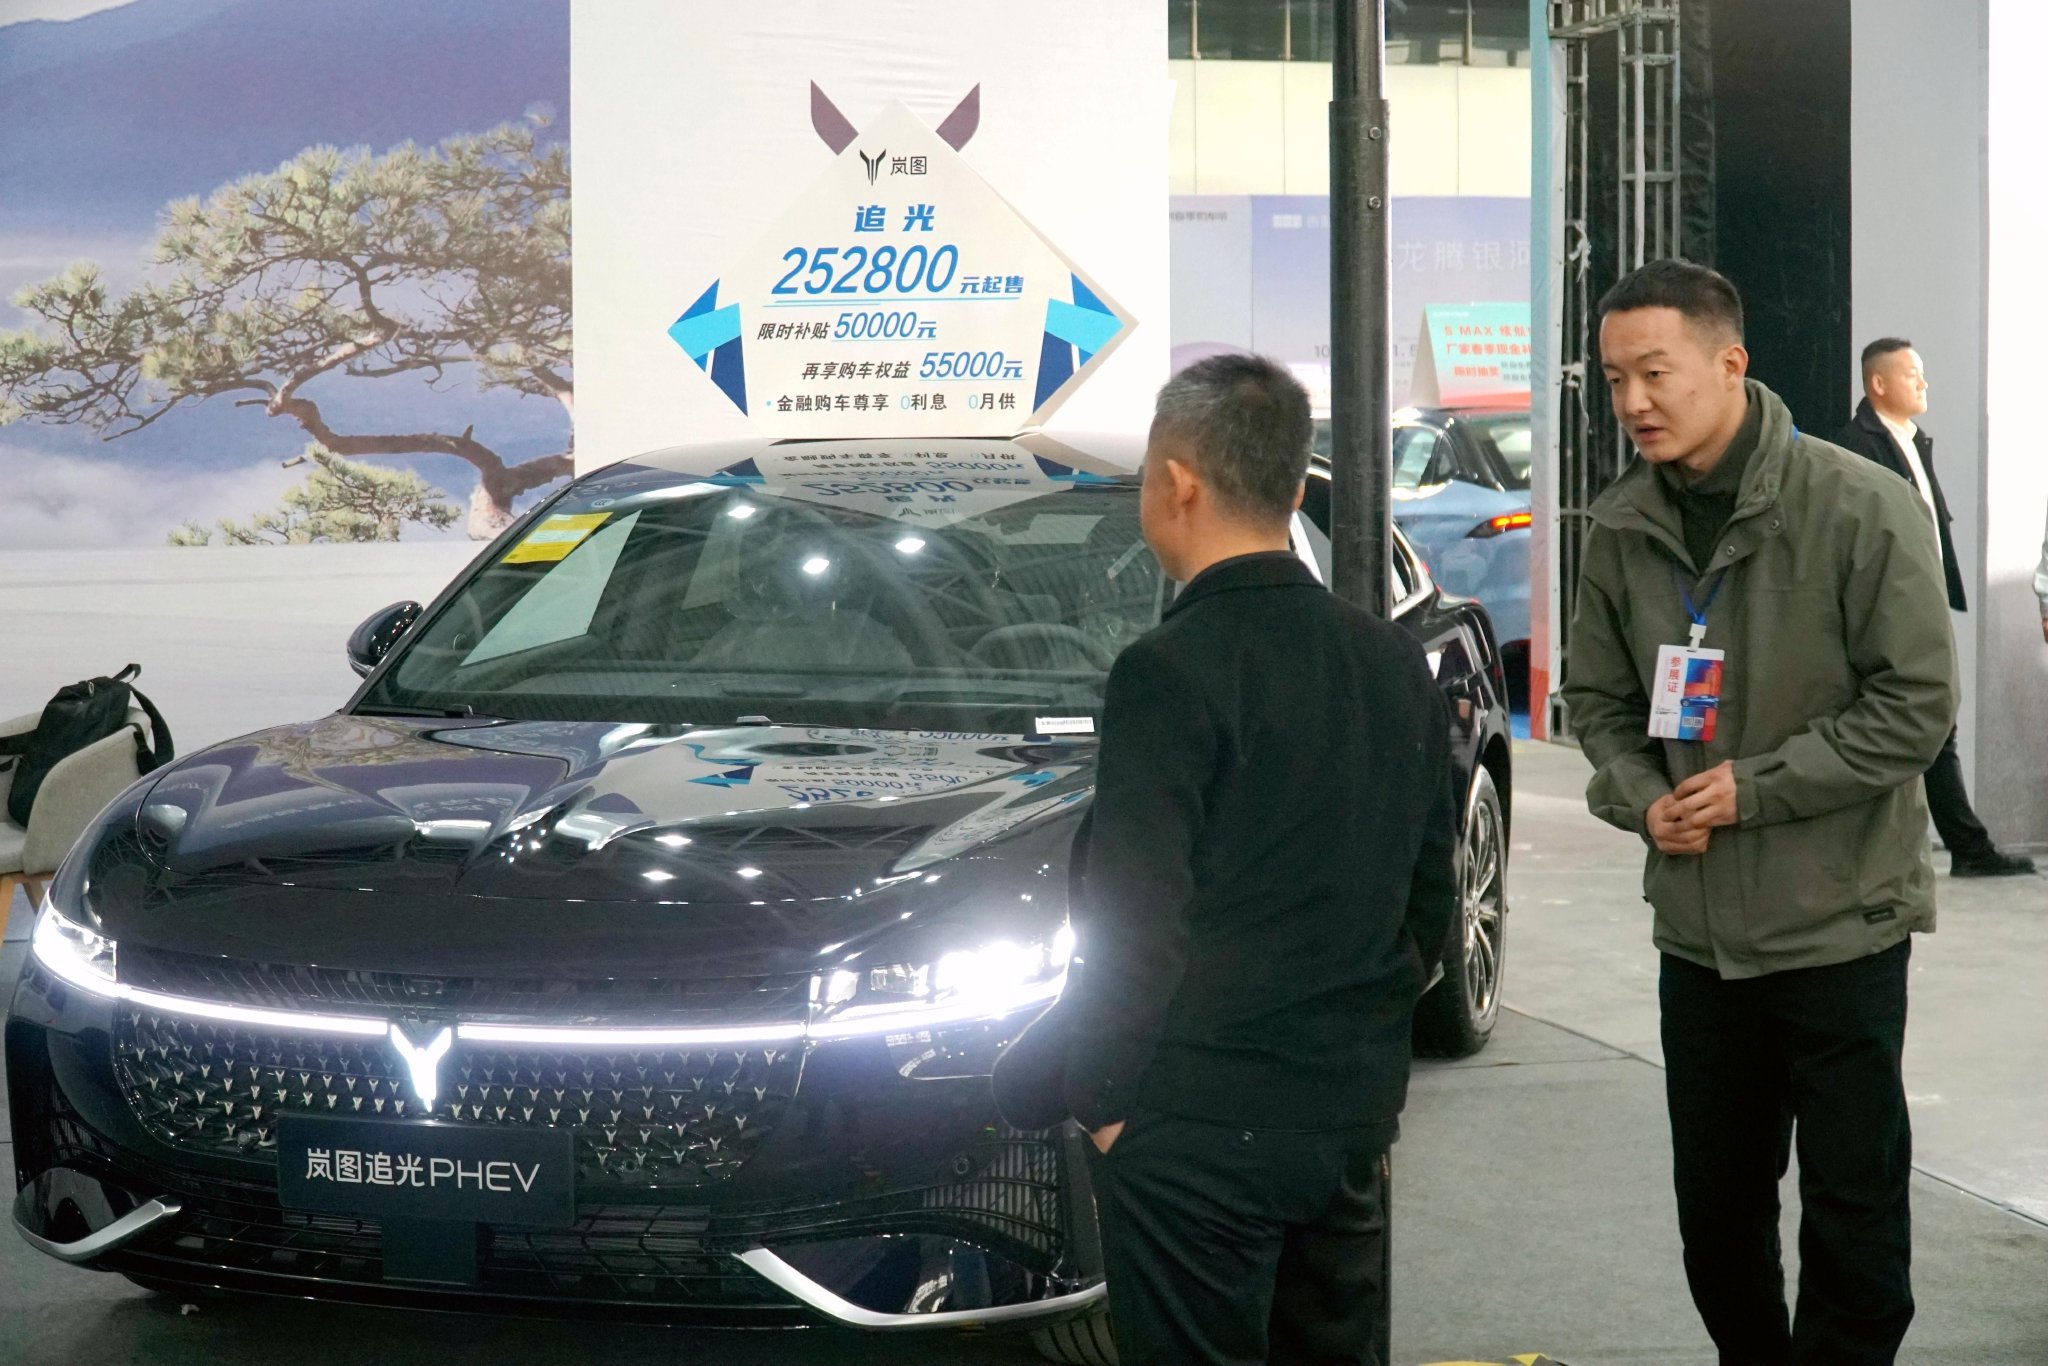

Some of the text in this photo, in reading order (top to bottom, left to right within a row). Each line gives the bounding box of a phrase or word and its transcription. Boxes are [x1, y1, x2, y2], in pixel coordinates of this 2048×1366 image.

[890, 156, 927, 176] 岚图
[854, 203, 935, 232] 追光
[1459, 326, 1493, 336] MAX
[801, 352, 1023, 380] 再享购车权益 55000元
[776, 394, 890, 412] 金融购车尊享
[1667, 656, 1682, 693] 参展证
